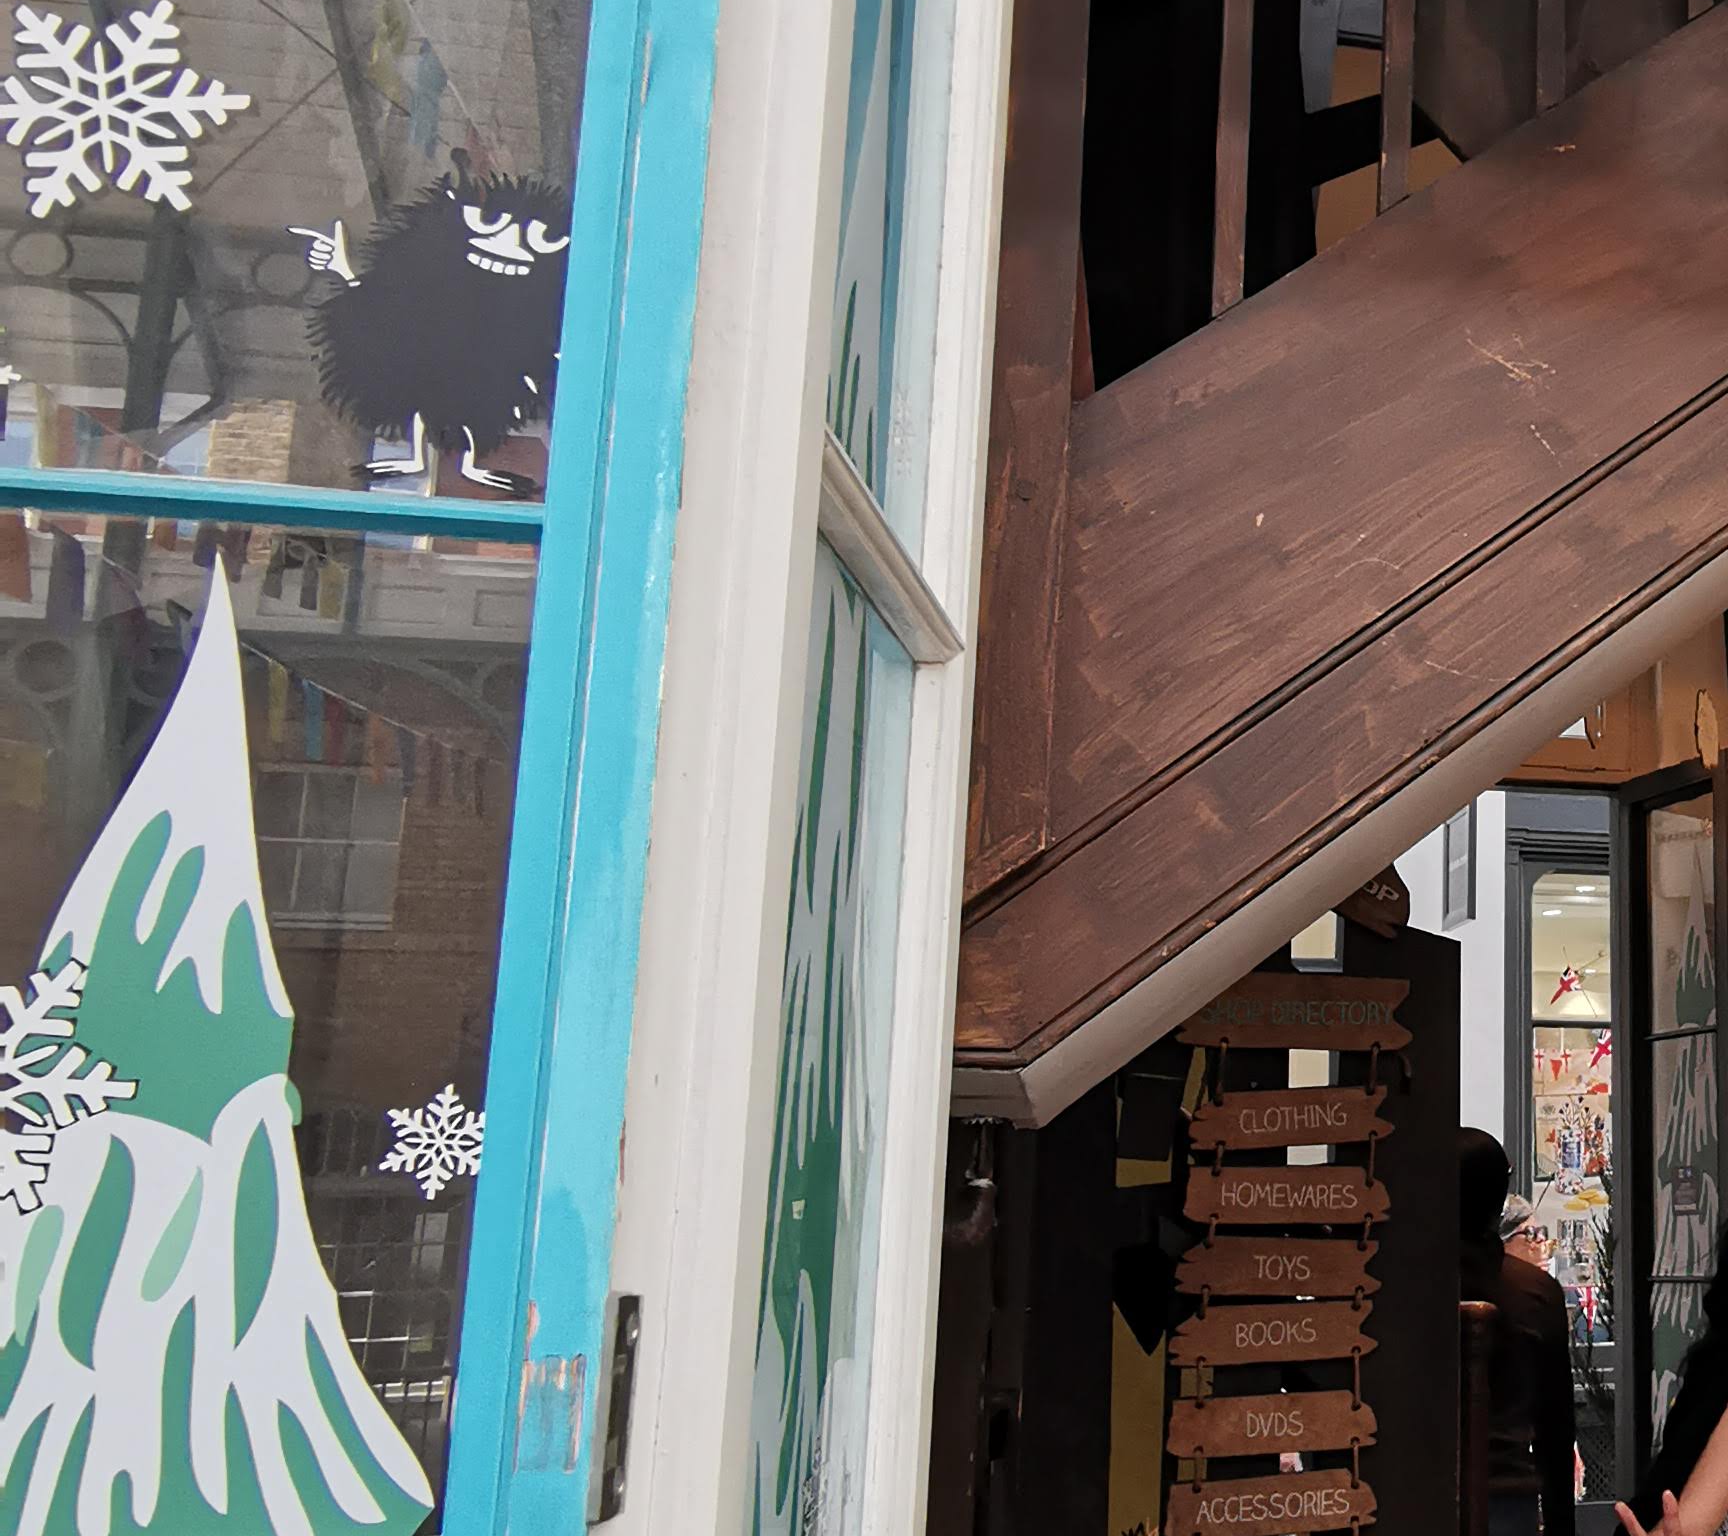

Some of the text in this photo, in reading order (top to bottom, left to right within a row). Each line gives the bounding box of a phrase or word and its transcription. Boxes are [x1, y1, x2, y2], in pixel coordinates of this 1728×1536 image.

[1199, 997, 1394, 1026] SHOP DIRECTORY
[1239, 1102, 1348, 1134] CLOTHING
[1220, 1182, 1358, 1210] HOMEWARES
[1253, 1254, 1312, 1281] TOYS
[1235, 1317, 1319, 1348] BOOKS
[1245, 1409, 1305, 1438] DVDS
[1195, 1488, 1351, 1525] ACCESSORIES
